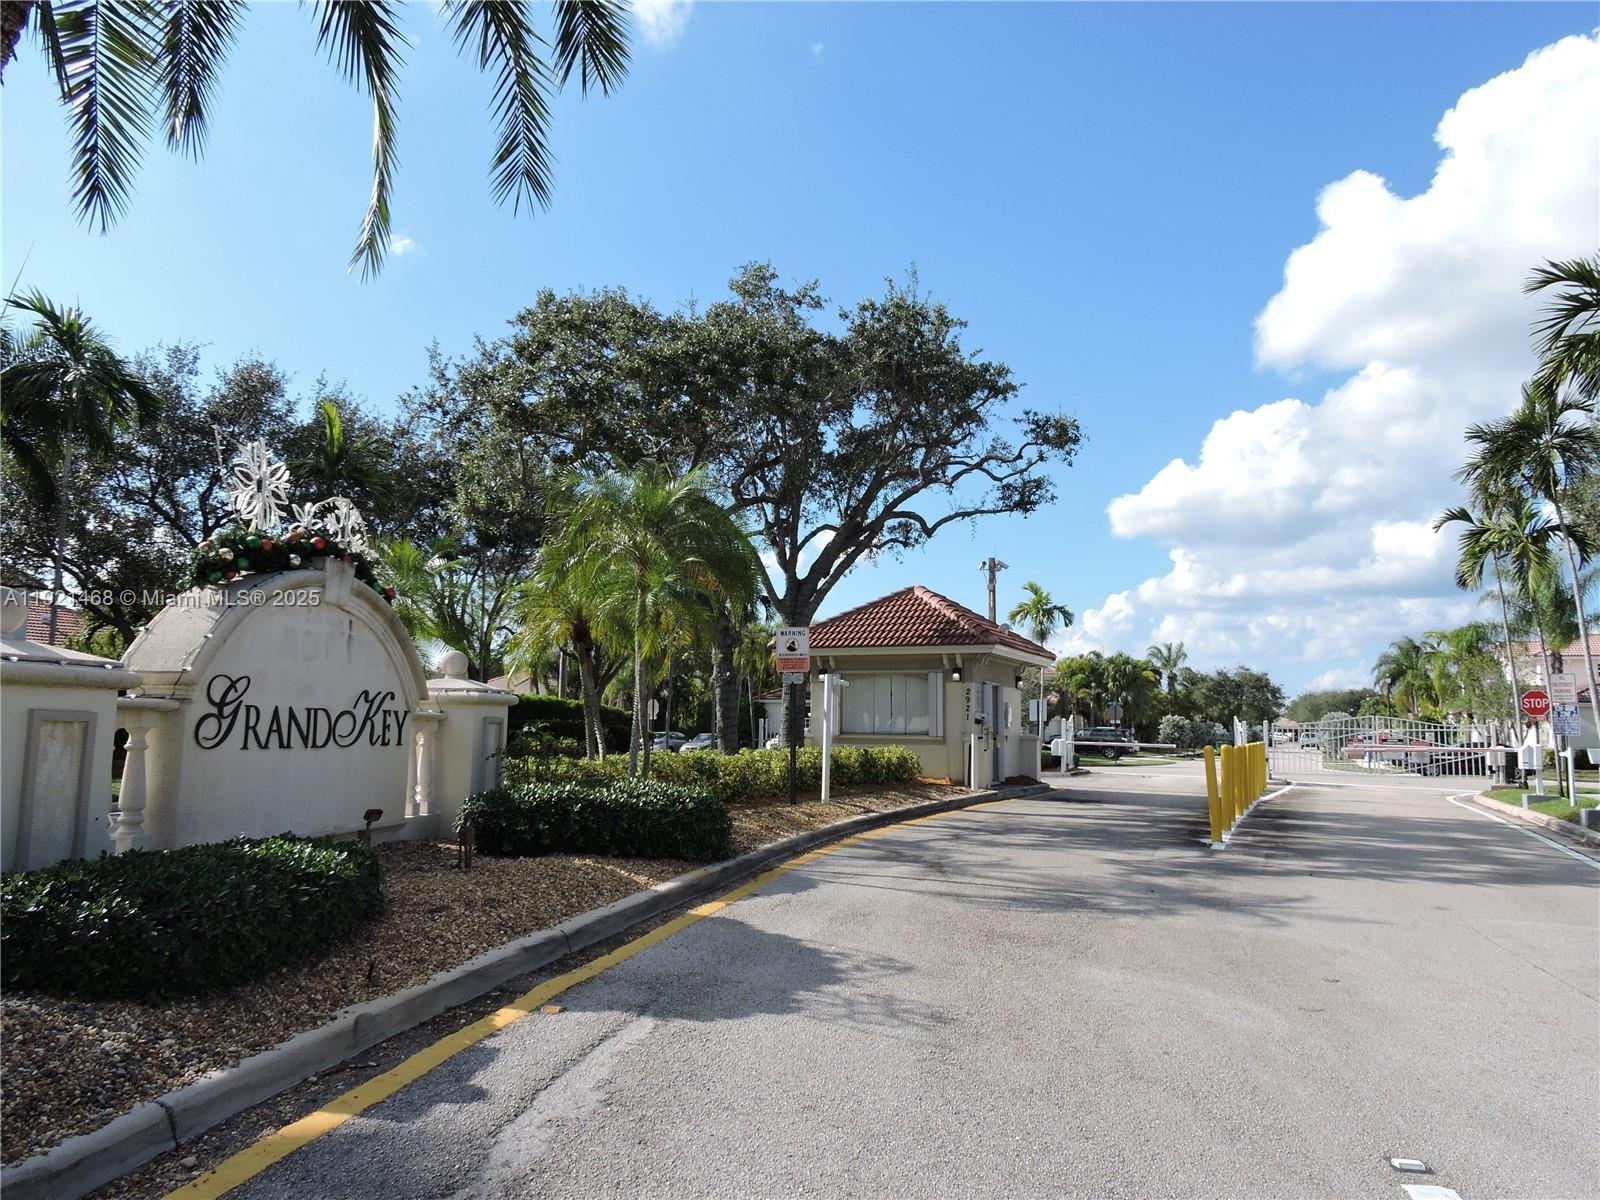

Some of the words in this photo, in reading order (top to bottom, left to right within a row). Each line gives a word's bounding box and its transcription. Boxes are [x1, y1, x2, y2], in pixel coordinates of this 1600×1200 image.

[194, 674, 333, 750] GRAND
[332, 689, 410, 748] KEY
[1523, 698, 1549, 709] STOP
